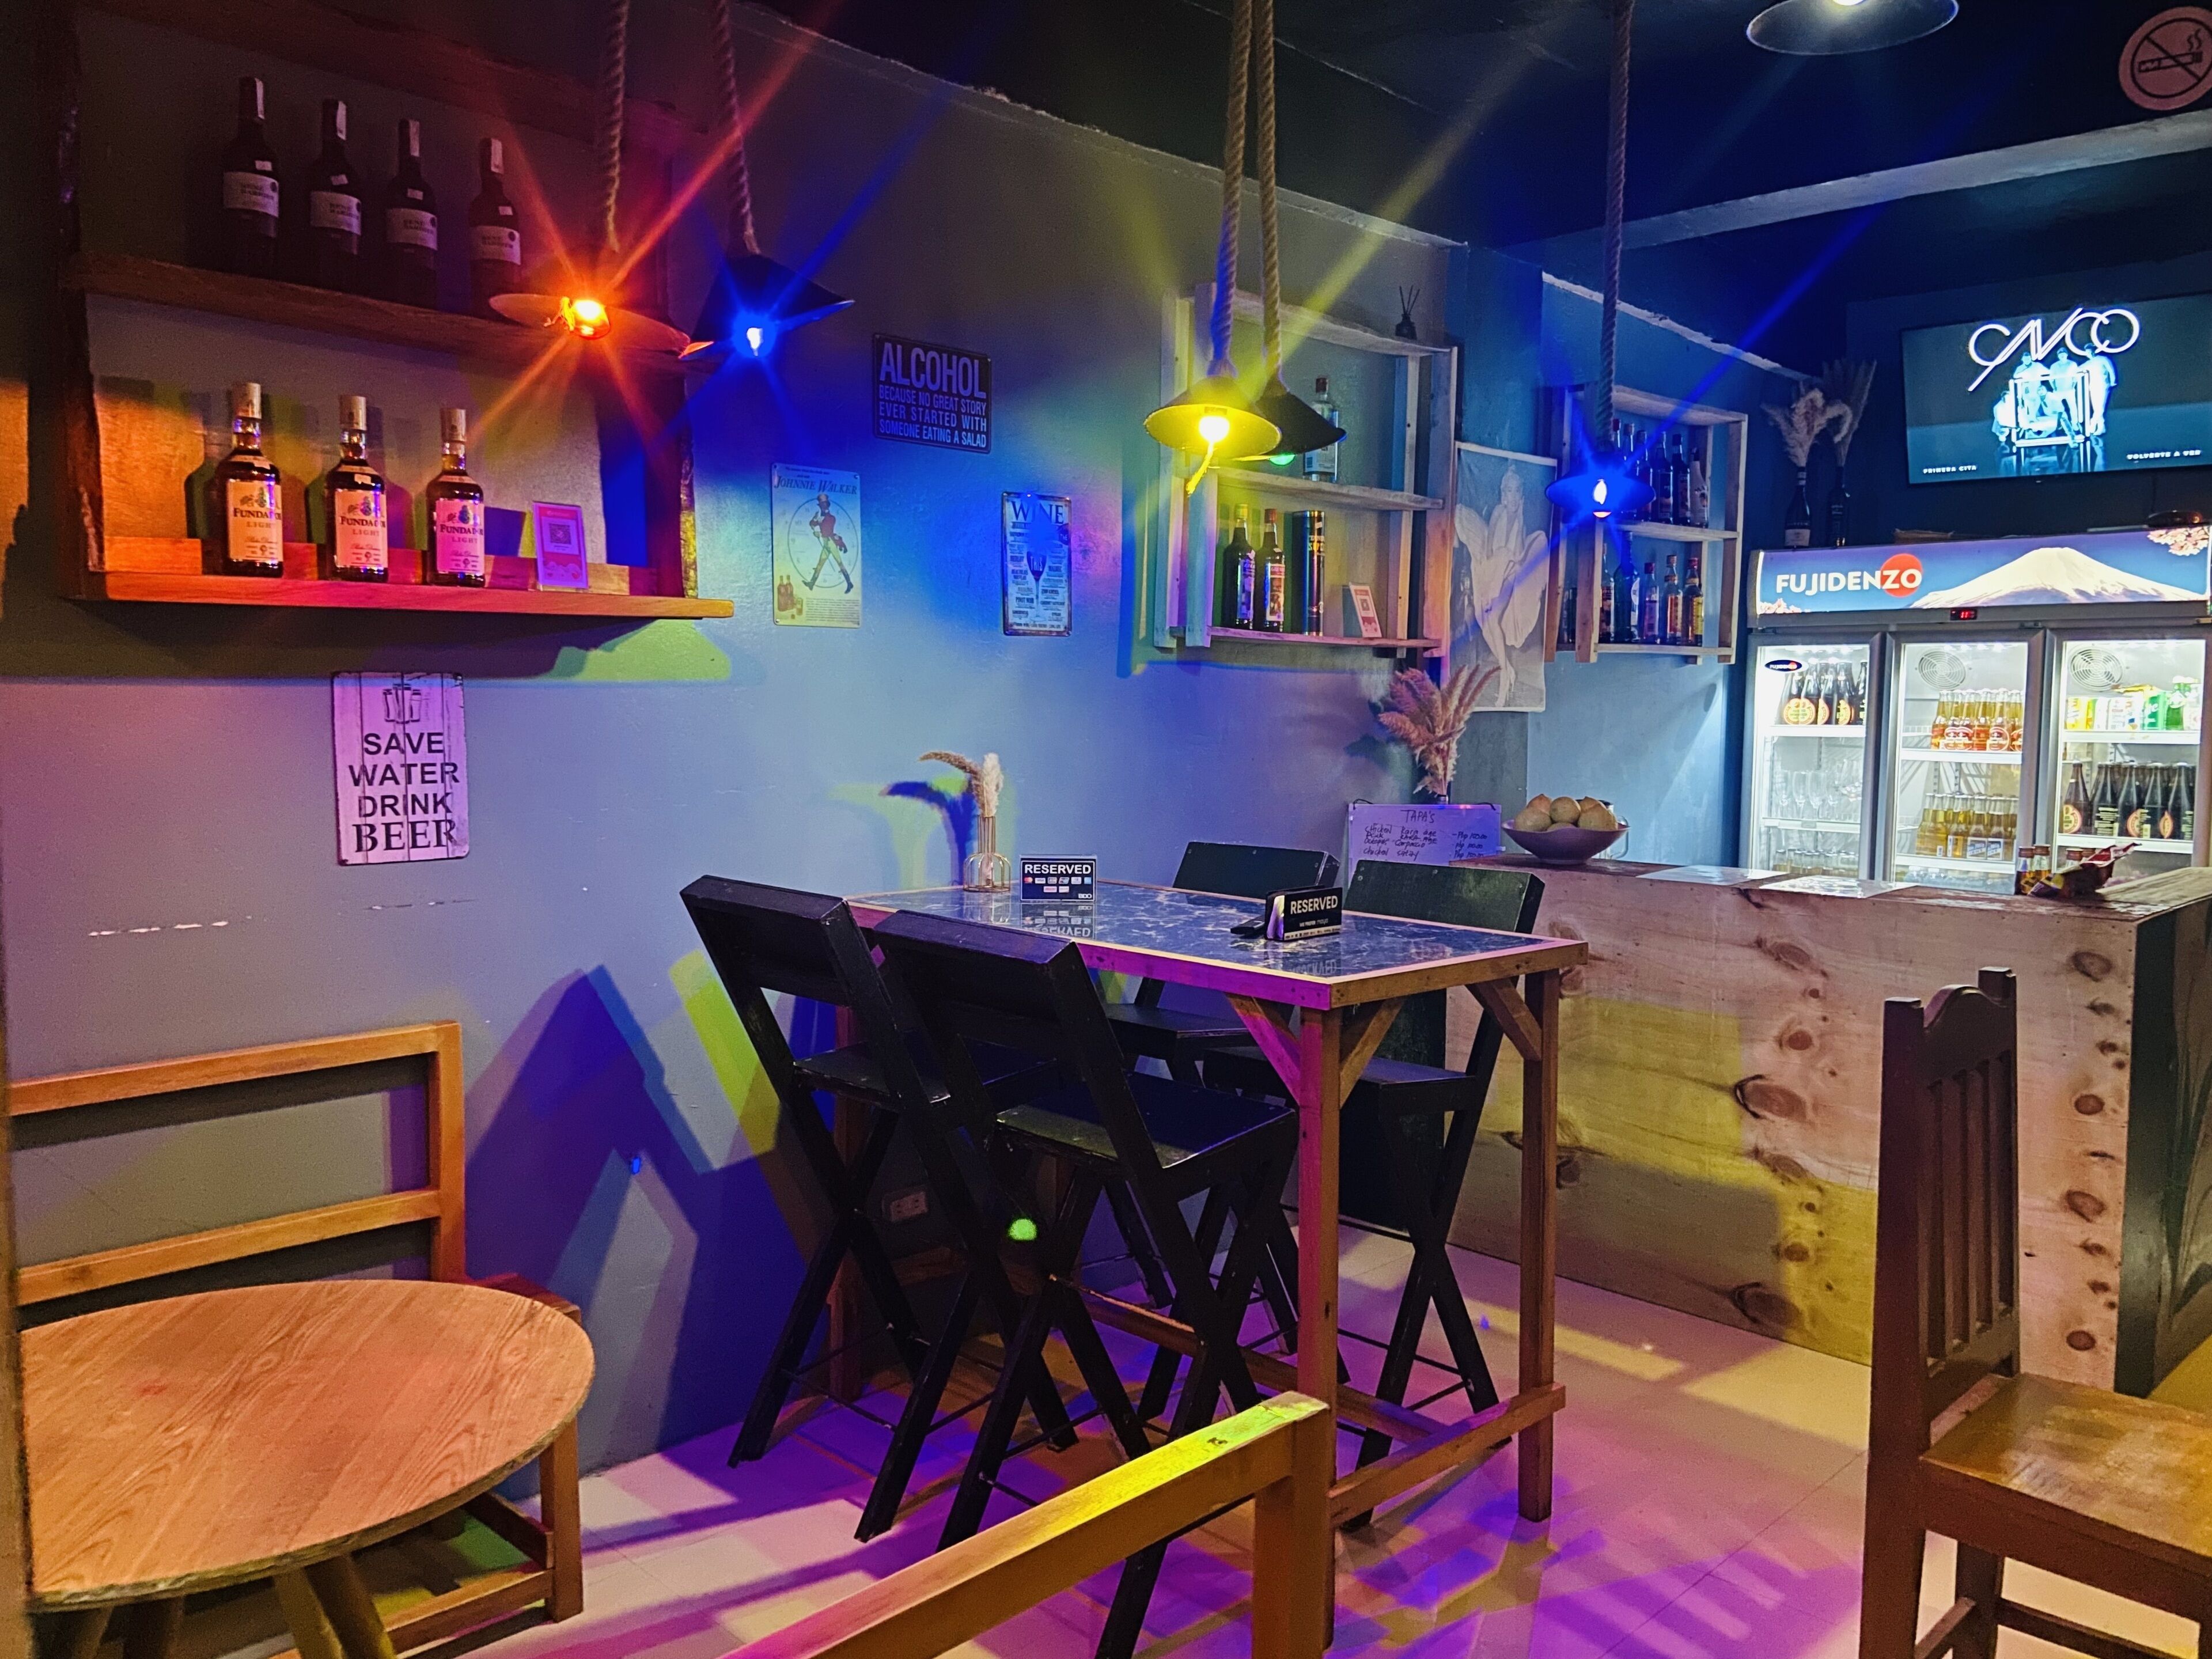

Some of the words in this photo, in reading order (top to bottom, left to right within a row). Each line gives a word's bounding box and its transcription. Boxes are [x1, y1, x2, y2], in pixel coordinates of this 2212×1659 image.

[880, 342, 987, 399] ALCOHOL
[879, 385, 916, 404] BECAUSE
[919, 392, 930, 407] NO
[933, 394, 958, 411] GREAT
[961, 399, 986, 415] STORY
[880, 402, 906, 419] EVER
[911, 407, 957, 427] STARTED
[961, 414, 987, 431] WITH
[880, 419, 920, 438] SOMEONE
[923, 426, 950, 443] EATING
[954, 431, 960, 444] A
[962, 431, 987, 448] SALAD
[774, 475, 816, 490] JOHNNIE
[818, 480, 857, 495] WALKER
[340, 516, 386, 528] FUNDADR
[1011, 501, 1064, 524] WINE
[440, 524, 483, 535] FUNDADR
[1776, 568, 1923, 597] FUJIDENZO
[363, 732, 444, 756] SAVE
[349, 762, 460, 787] WATER
[358, 792, 453, 818] DRINK
[353, 819, 457, 853] BEER
[1025, 864, 1092, 874] RESERVED
[1290, 896, 1339, 915] RESERVED
